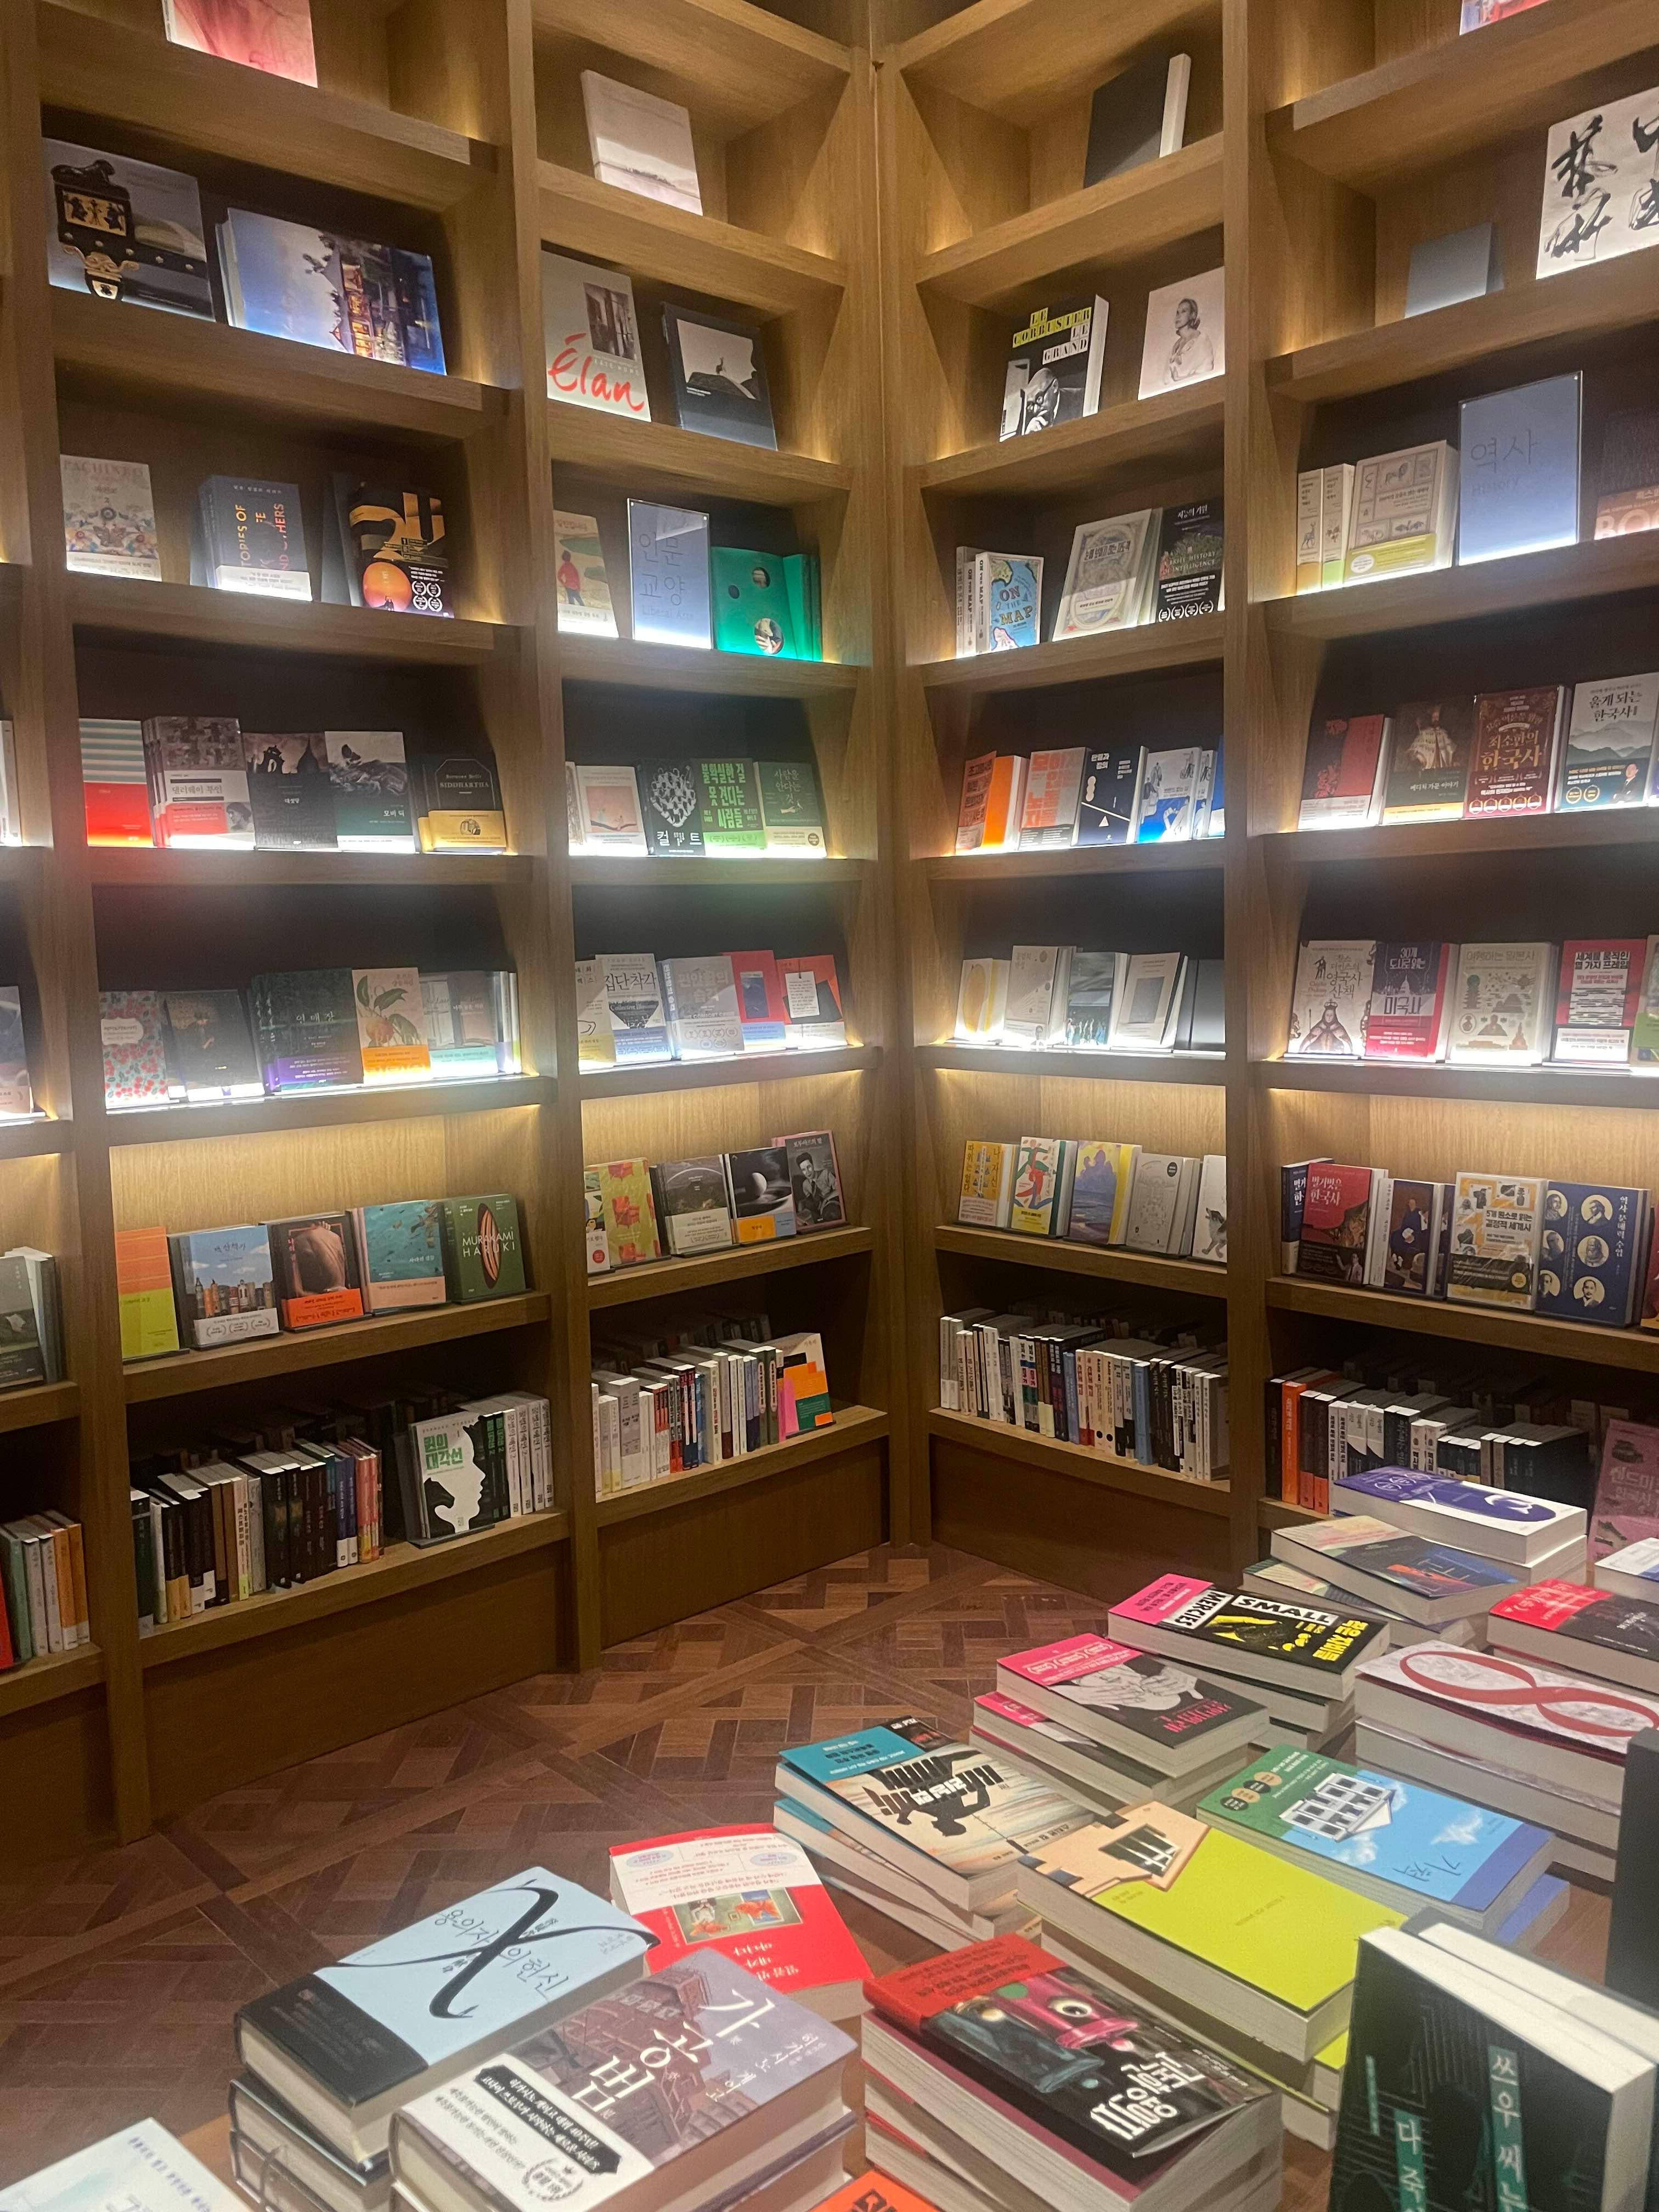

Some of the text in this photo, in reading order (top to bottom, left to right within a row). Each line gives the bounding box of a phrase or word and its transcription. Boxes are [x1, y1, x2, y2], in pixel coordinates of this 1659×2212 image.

[1071, 324, 1088, 341] LE
[1043, 338, 1088, 364] GRAND
[1470, 430, 1538, 473] 역사
[1000, 585, 1020, 602] ON
[1000, 606, 1033, 625] MAP
[1594, 705, 1630, 722] 한국사
[1481, 744, 1542, 772] 한국사
[701, 763, 735, 784] 불확실한
[774, 768, 799, 781] 사람을
[717, 808, 744, 829] 사람들
[1400, 947, 1418, 958] 30개
[1602, 961, 1629, 969] 프레임
[605, 973, 630, 991] 집단
[630, 971, 657, 991] 착각
[1327, 972, 1362, 986] 영국사
[1384, 996, 1422, 1014] 미국사
[1312, 1176, 1342, 1190] 벌거벗은
[1311, 1189, 1341, 1206] 한국사
[1619, 1196, 1628, 1213] 역사
[1486, 1219, 1531, 1232] 결정적 세계사
[462, 1231, 514, 1247] MURAKAMI
[462, 1244, 515, 1258] HARUKI
[425, 1447, 464, 1470] 대각선
[1174, 1592, 1223, 1627] MERCIES
[1239, 1599, 1332, 1624] SMALL
[1313, 1620, 1370, 1662] 작은 자비들
[910, 1777, 967, 1805] 러닝 맨
[432, 1908, 499, 1949] 용의자
[518, 1957, 571, 2000] 헌신
[571, 1988, 776, 2111] 가공범
[706, 2033, 820, 2102] 히가시노 게이고
[1120, 2052, 1206, 2097] 고독한
[1090, 2084, 1178, 2140] 용의자
[1396, 2119, 1422, 2155] 다
